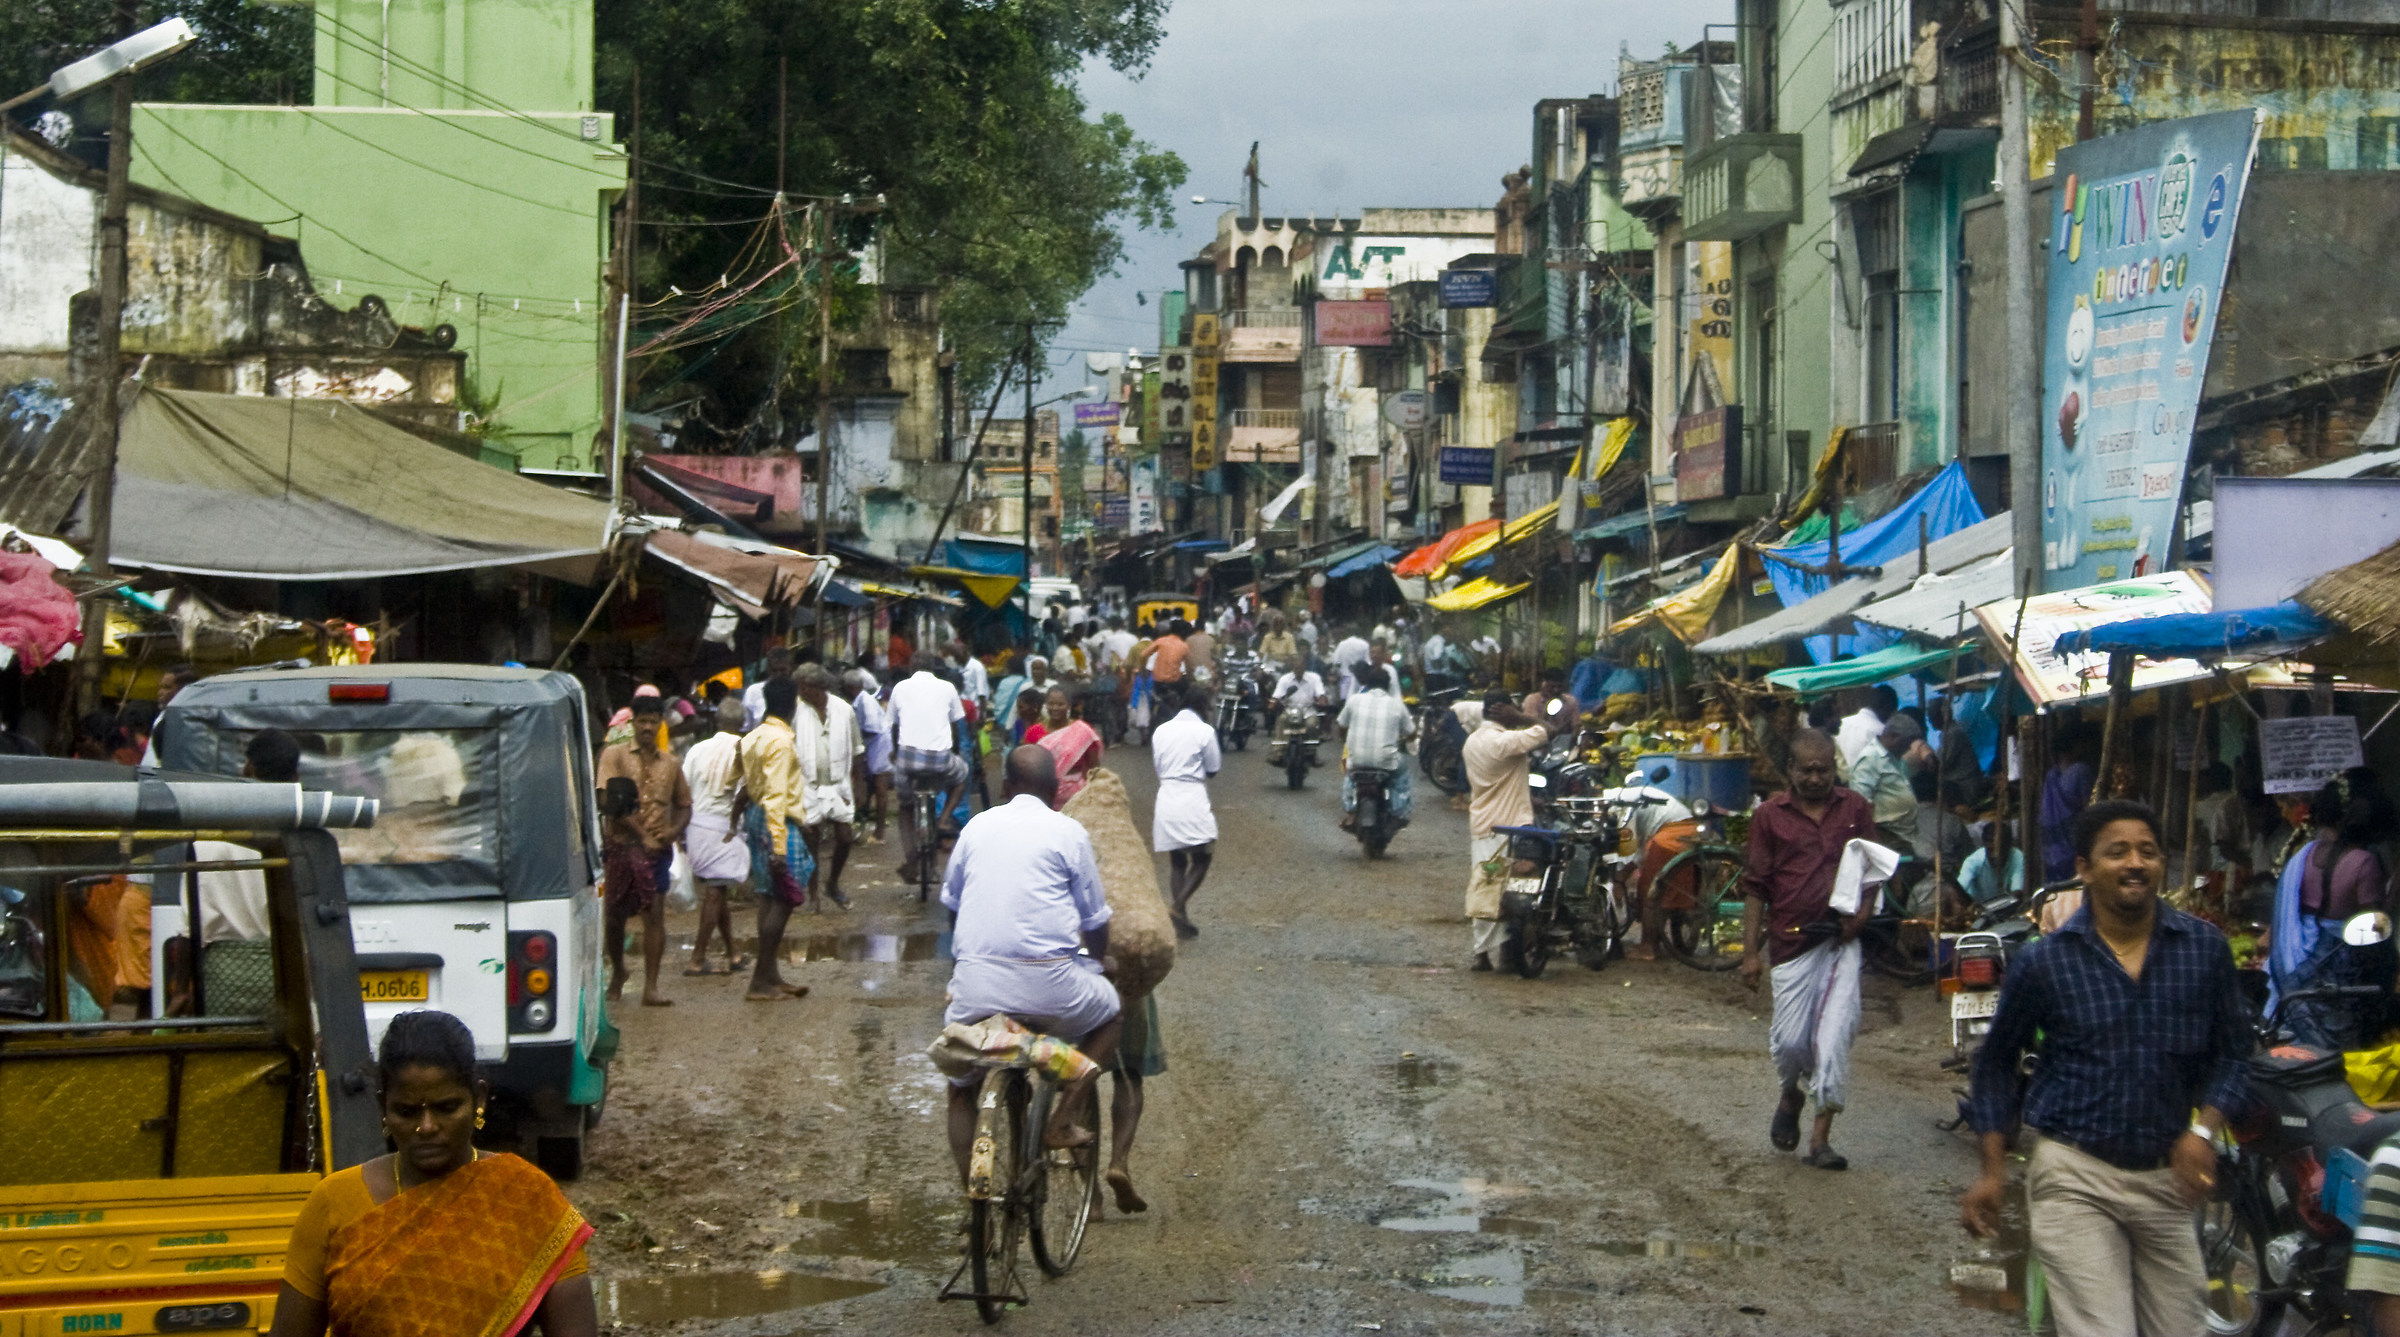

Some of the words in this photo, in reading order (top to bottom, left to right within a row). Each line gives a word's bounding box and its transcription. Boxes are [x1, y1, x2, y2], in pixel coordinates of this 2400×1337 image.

[2094, 174, 2156, 254] WIN
[454, 922, 491, 933] magic
[62, 1313, 122, 1333] HORN
